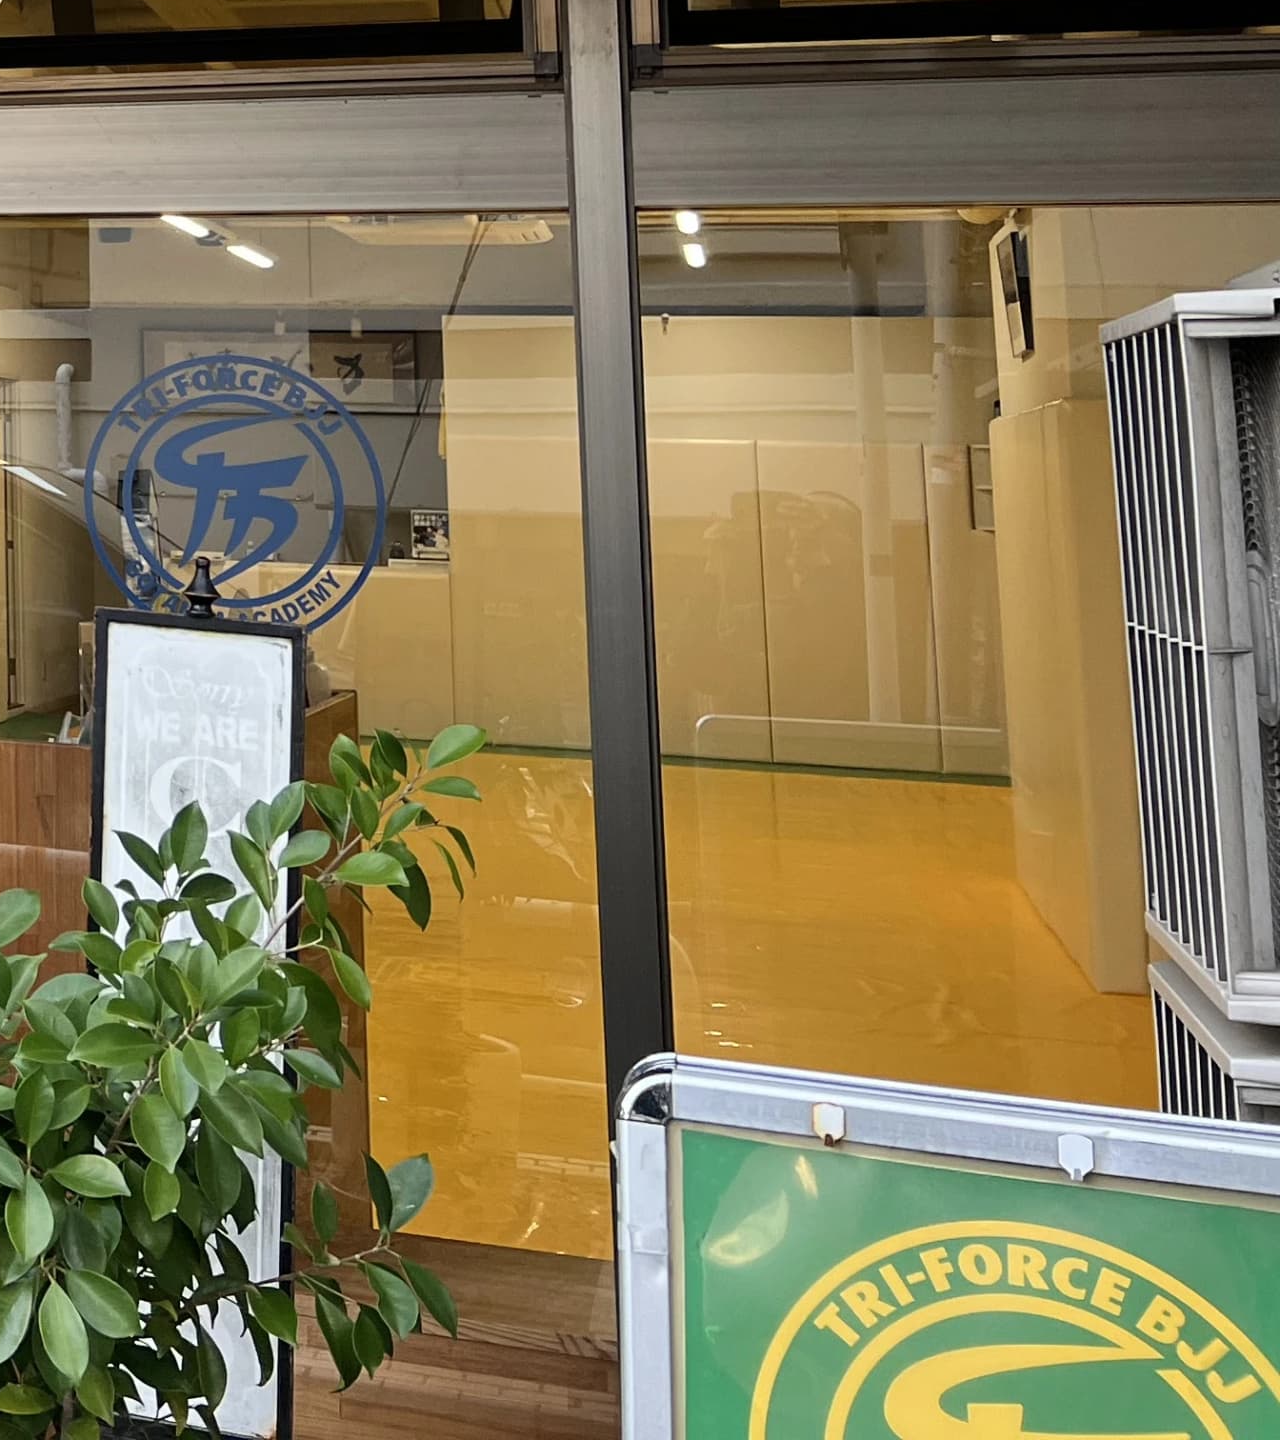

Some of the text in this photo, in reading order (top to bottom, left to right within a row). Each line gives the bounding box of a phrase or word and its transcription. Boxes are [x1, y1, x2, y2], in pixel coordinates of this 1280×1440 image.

[118, 367, 282, 434] TRI-FORCE
[282, 381, 343, 436] BJJ
[194, 714, 259, 752] ARE
[814, 1243, 1261, 1406] TRI-FORCE BJJ
